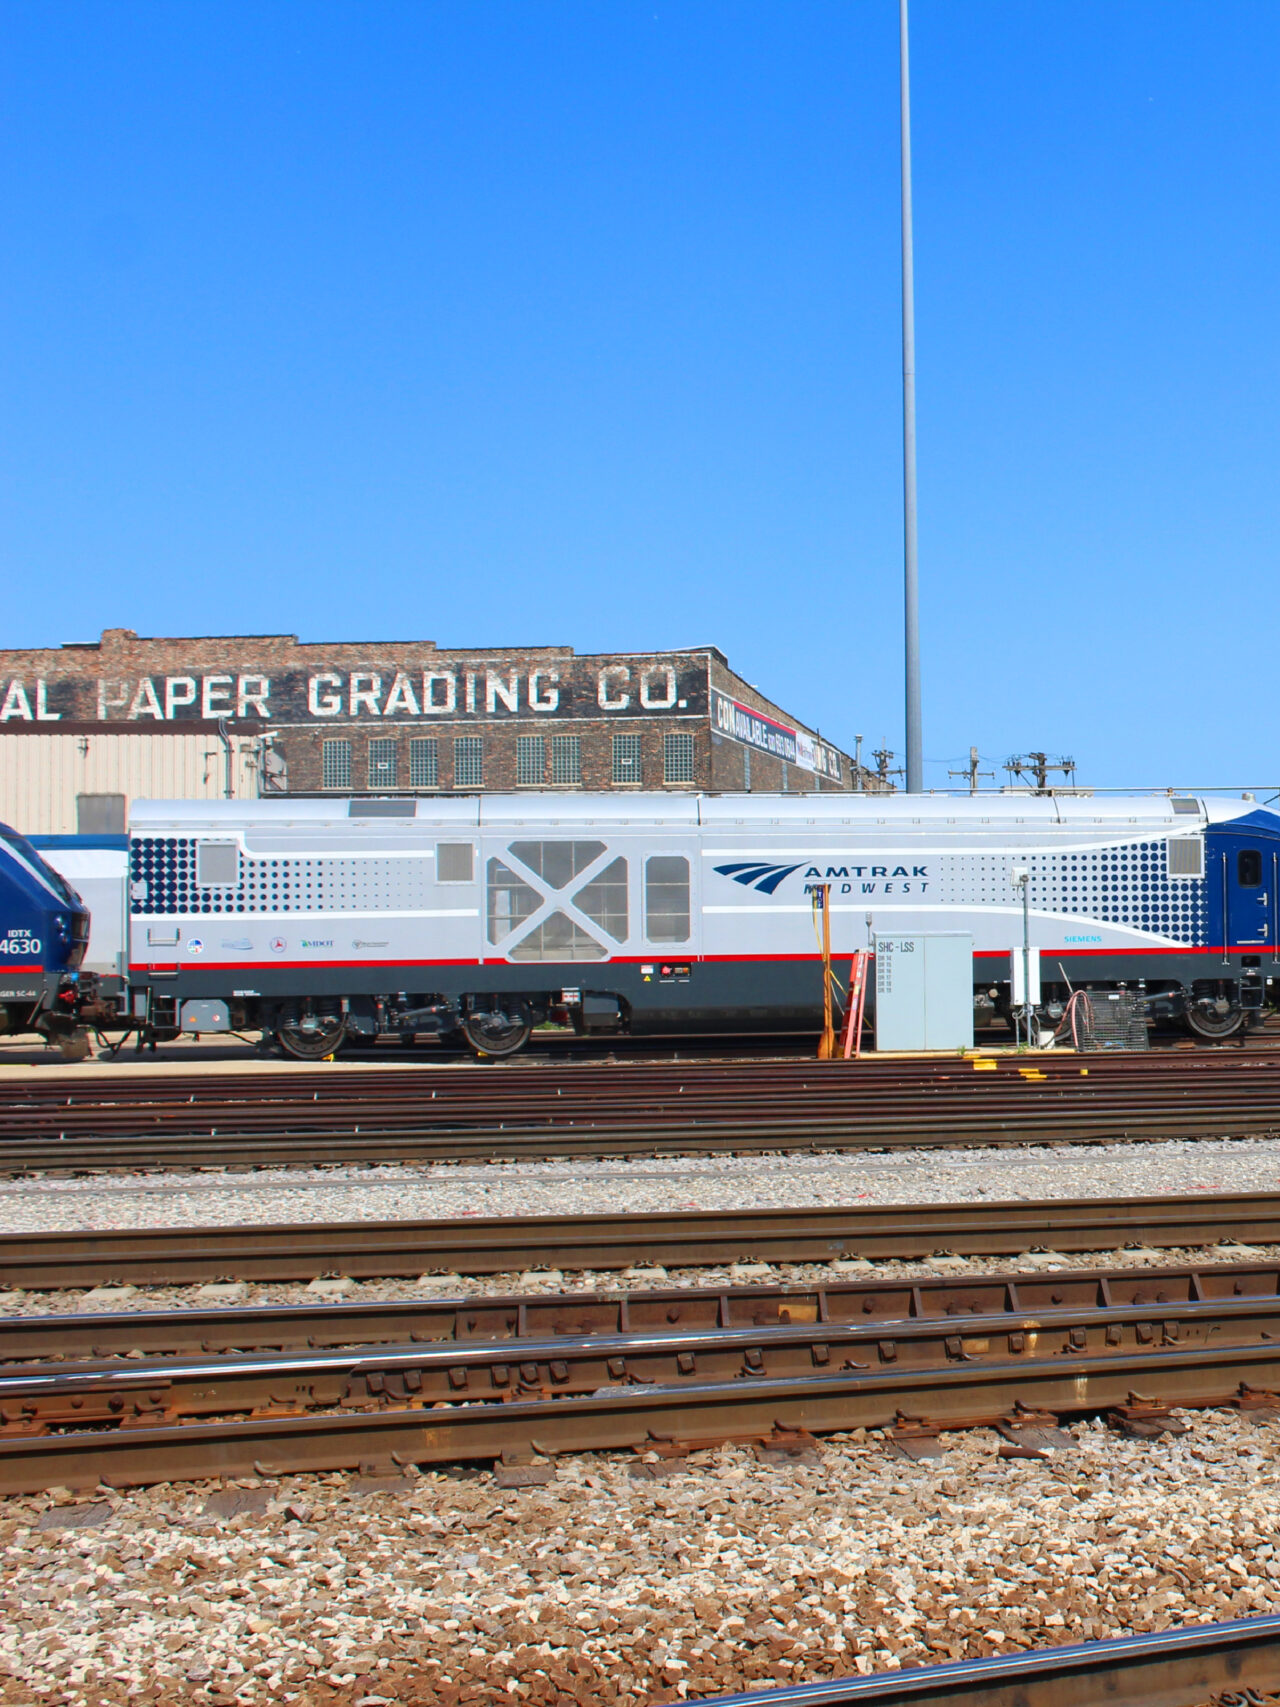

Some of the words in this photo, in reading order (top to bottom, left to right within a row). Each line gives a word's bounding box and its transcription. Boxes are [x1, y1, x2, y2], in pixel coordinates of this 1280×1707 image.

[96, 674, 272, 720] PAPER
[307, 669, 560, 716] GRADING
[597, 664, 687, 711] CO.
[735, 711, 768, 748] AVAILABLE
[803, 865, 928, 878] AMTRAK
[8, 929, 32, 938] IDTX
[1064, 935, 1102, 943] SIEMENS
[0, 938, 42, 954] 4630
[878, 941, 894, 953] SHC
